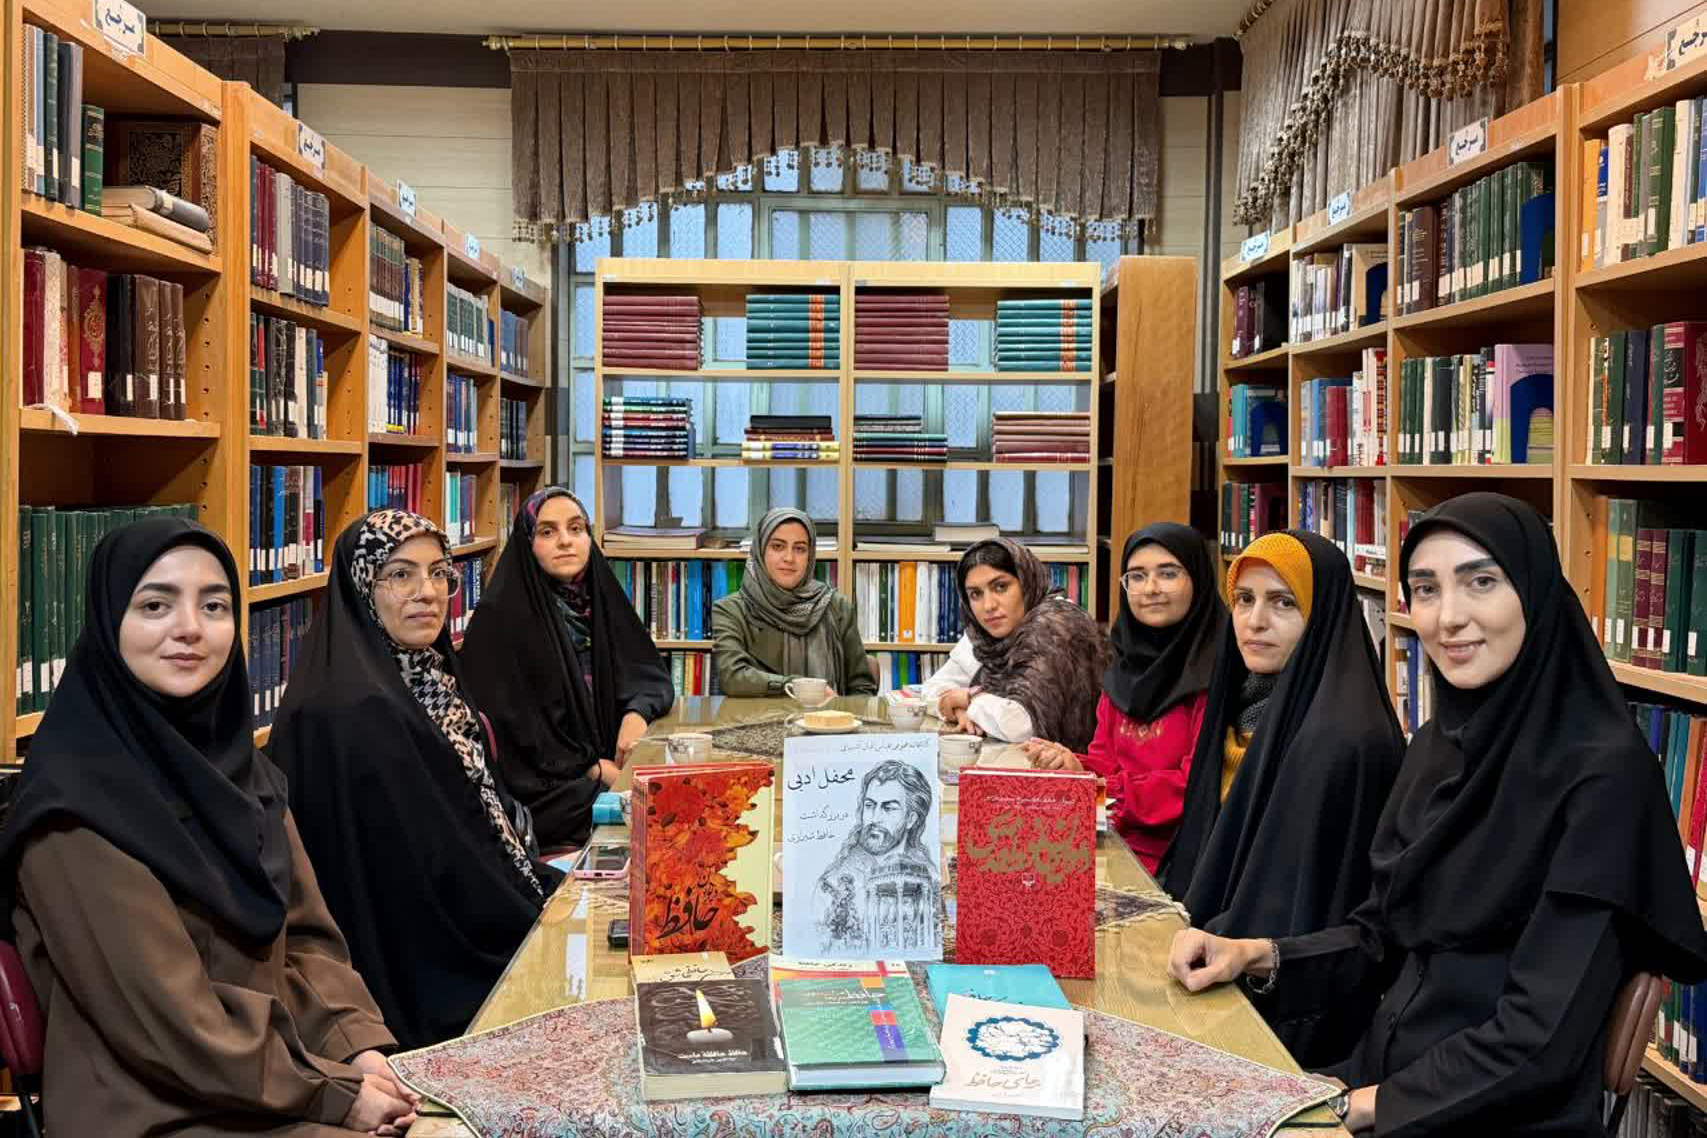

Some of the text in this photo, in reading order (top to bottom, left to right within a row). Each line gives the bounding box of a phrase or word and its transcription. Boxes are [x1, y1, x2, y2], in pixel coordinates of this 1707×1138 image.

[104, 8, 136, 34] مرجع
[1679, 32, 1707, 56] رجع
[1455, 135, 1479, 156] مرجع
[787, 763, 856, 791] محفل ادبی
[656, 883, 719, 938] حافظ
[962, 1071, 1003, 1089] حافظ
